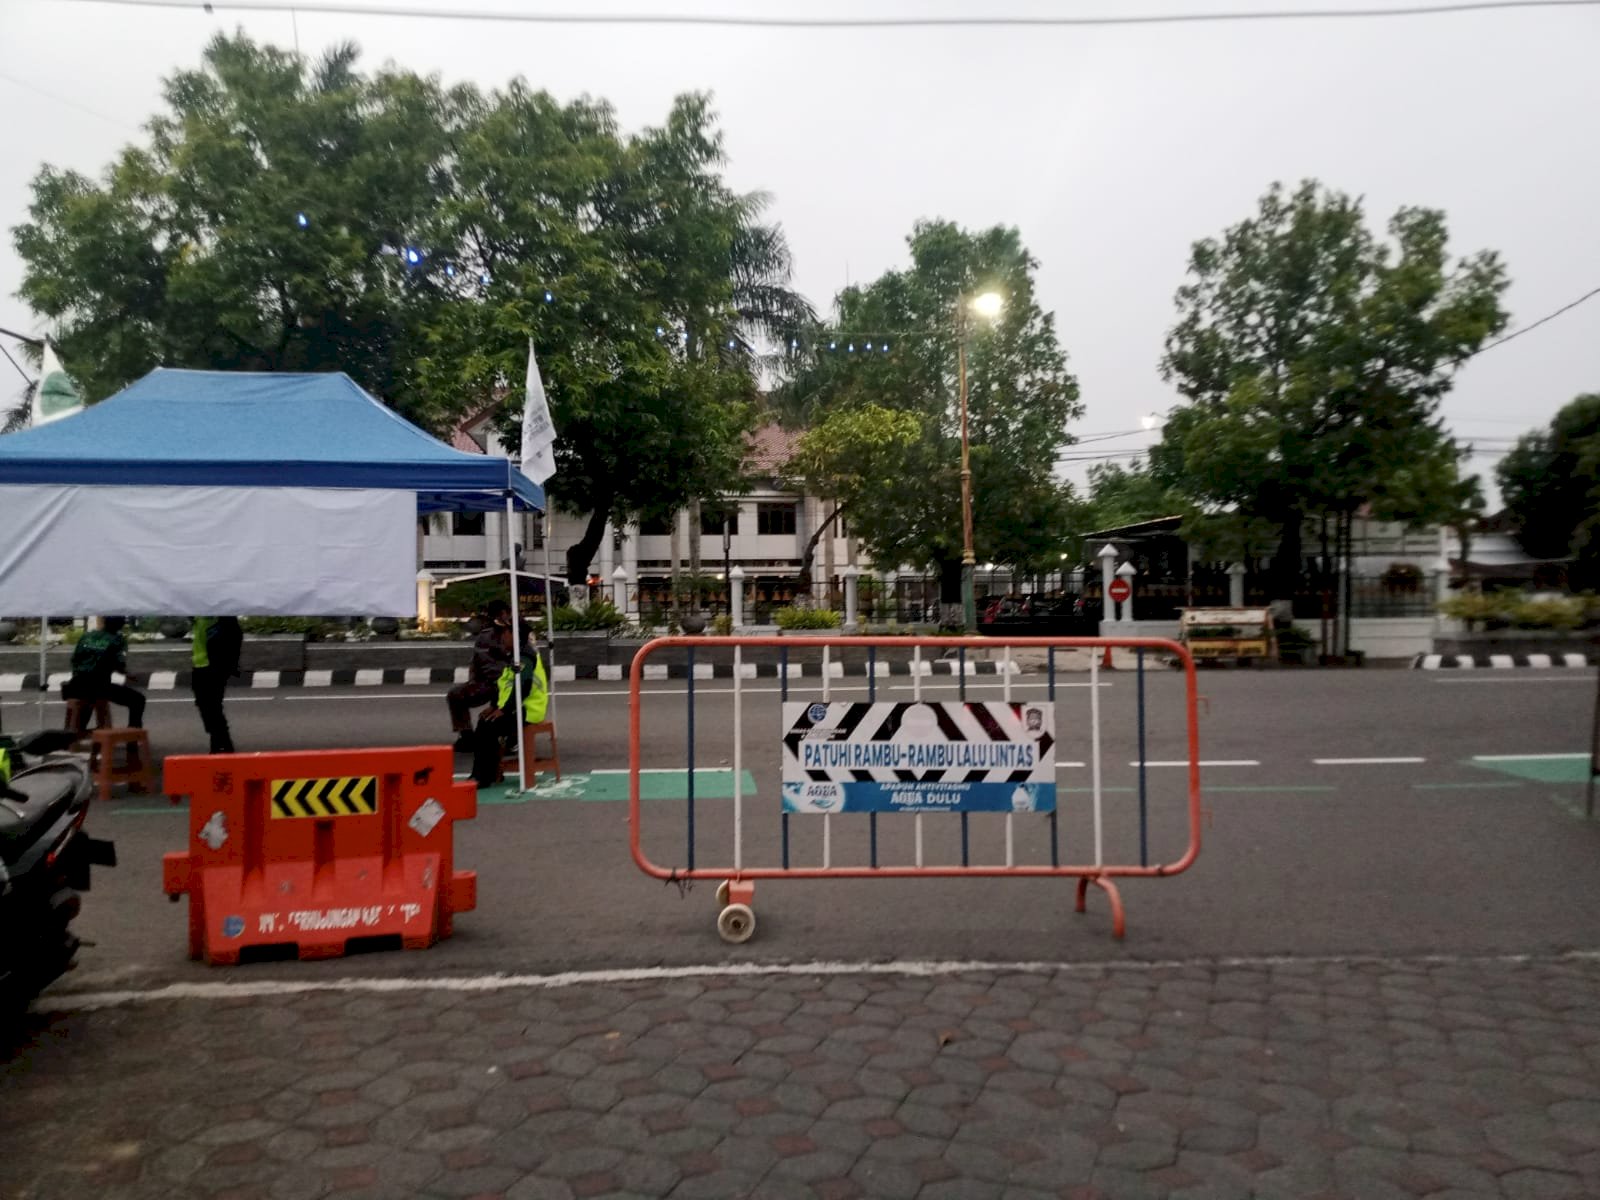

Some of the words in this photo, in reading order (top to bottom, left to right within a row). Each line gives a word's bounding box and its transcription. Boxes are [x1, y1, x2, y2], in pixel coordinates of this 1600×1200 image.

[805, 744, 851, 767] PATUHI
[854, 744, 954, 767] RAMBU-RAMBU
[957, 744, 987, 767] LALU
[990, 744, 1033, 767] LINTAS
[891, 792, 922, 804] AQUA
[926, 792, 961, 804] DULU
